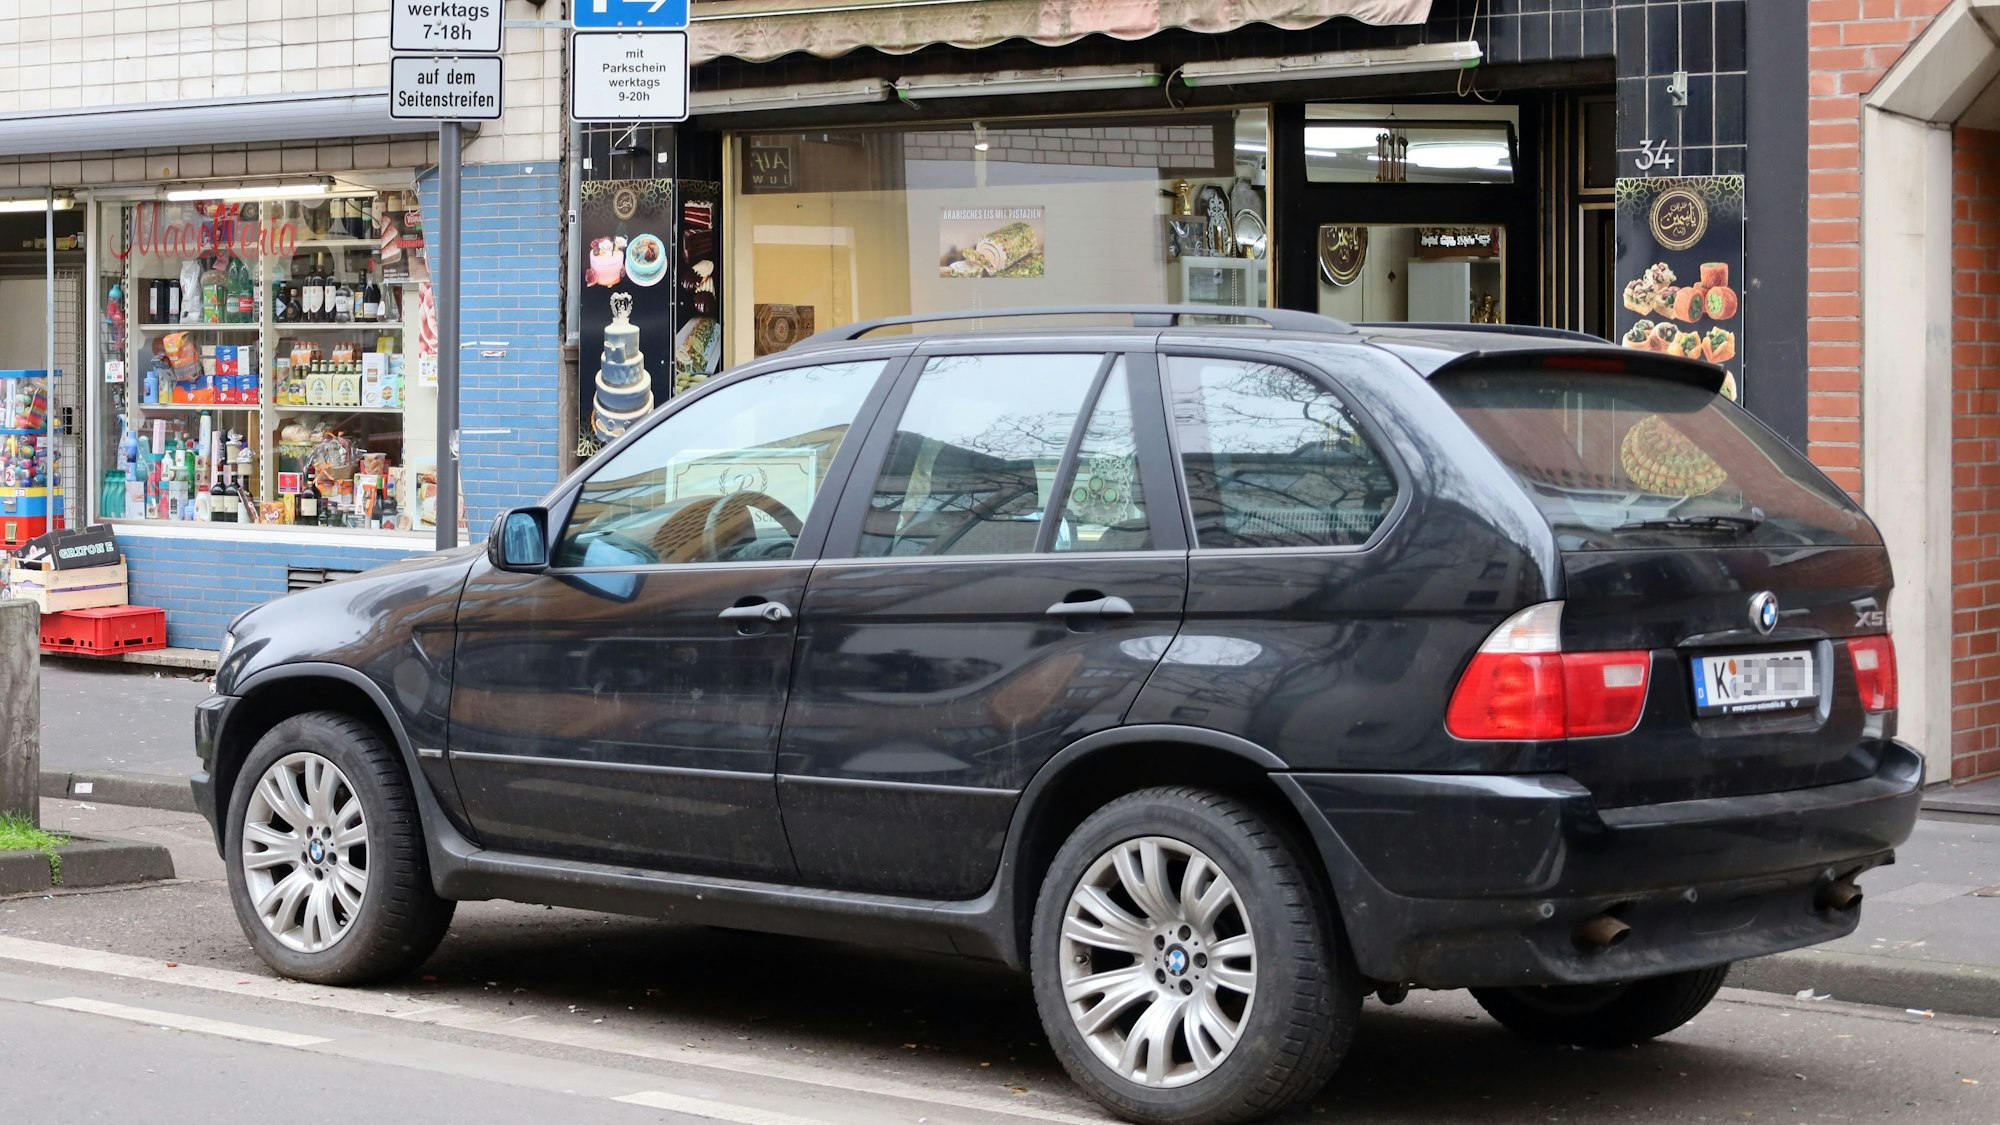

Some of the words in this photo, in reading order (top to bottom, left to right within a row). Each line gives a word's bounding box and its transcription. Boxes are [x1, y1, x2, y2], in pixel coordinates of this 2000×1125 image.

[408, 2, 489, 21] werktags
[423, 24, 472, 40] 7-18h
[626, 48, 644, 58] mit
[602, 62, 666, 73] Parkschein
[417, 68, 440, 85] auf
[447, 68, 476, 85] dem
[608, 77, 661, 89] werktags
[398, 90, 494, 107] Seitenstreifen
[618, 91, 650, 101] 9-20h
[1634, 139, 1675, 170] 34
[943, 209, 982, 220] ARABISCHES
[983, 209, 994, 219] EIS
[995, 209, 1008, 219] MIT
[1009, 208, 1041, 219] PISTAZIEN
[109, 200, 298, 260] Macelleria
[1855, 611, 1884, 627] X5
[1714, 661, 1730, 699] K
